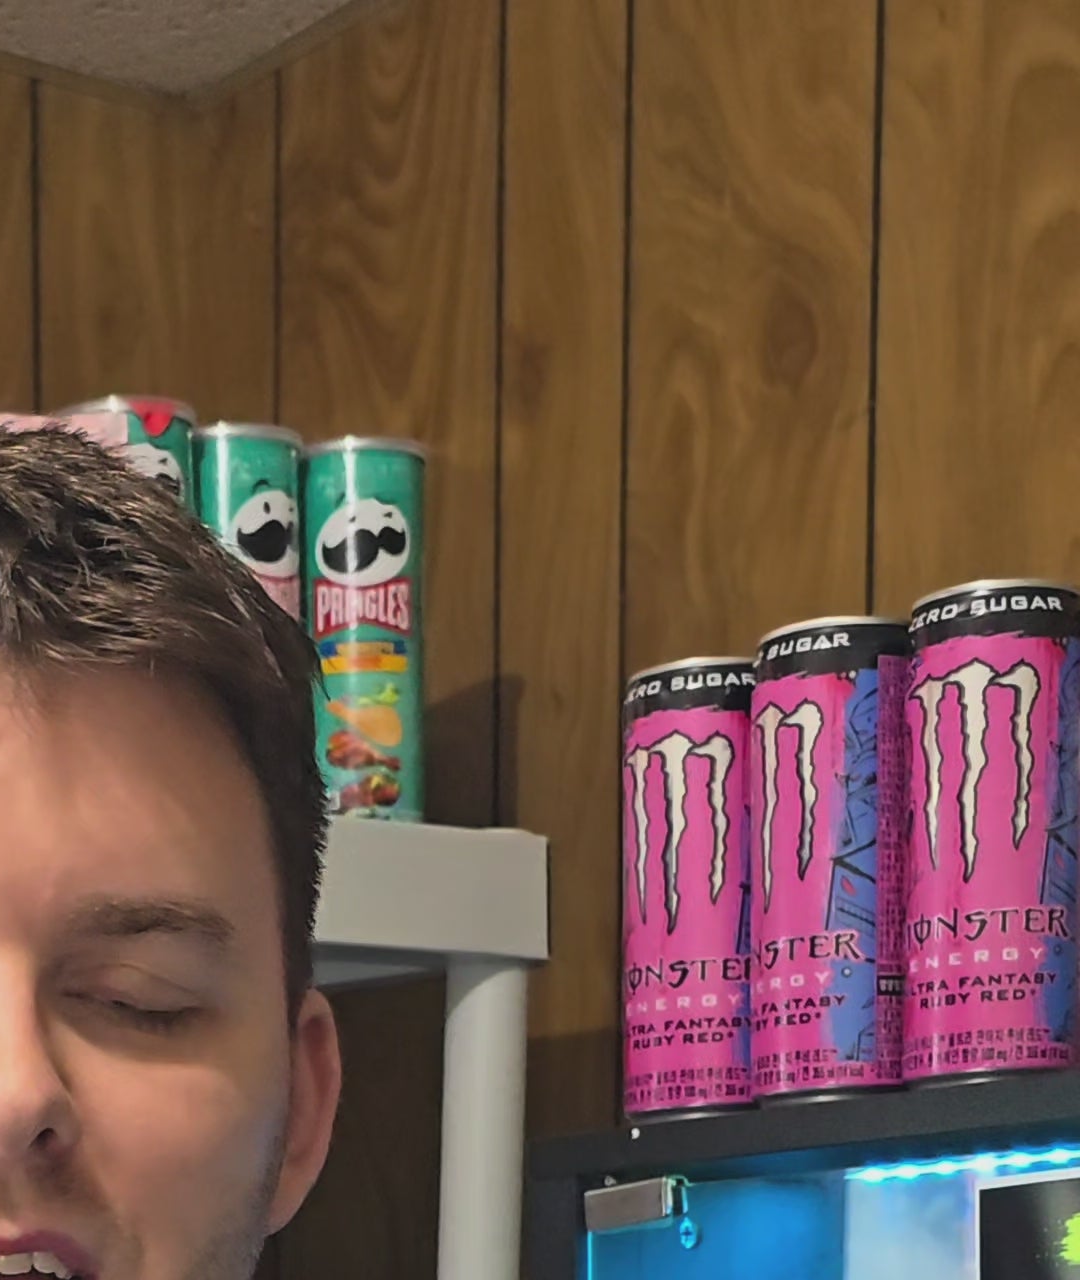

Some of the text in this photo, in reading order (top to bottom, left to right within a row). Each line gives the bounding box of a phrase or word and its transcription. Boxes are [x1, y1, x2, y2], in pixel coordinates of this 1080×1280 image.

[970, 595, 1063, 616] SUGAR
[766, 632, 851, 660] SUGAR
[670, 672, 756, 692] SUGAR
[911, 972, 1057, 997] LTRA FANTASY
